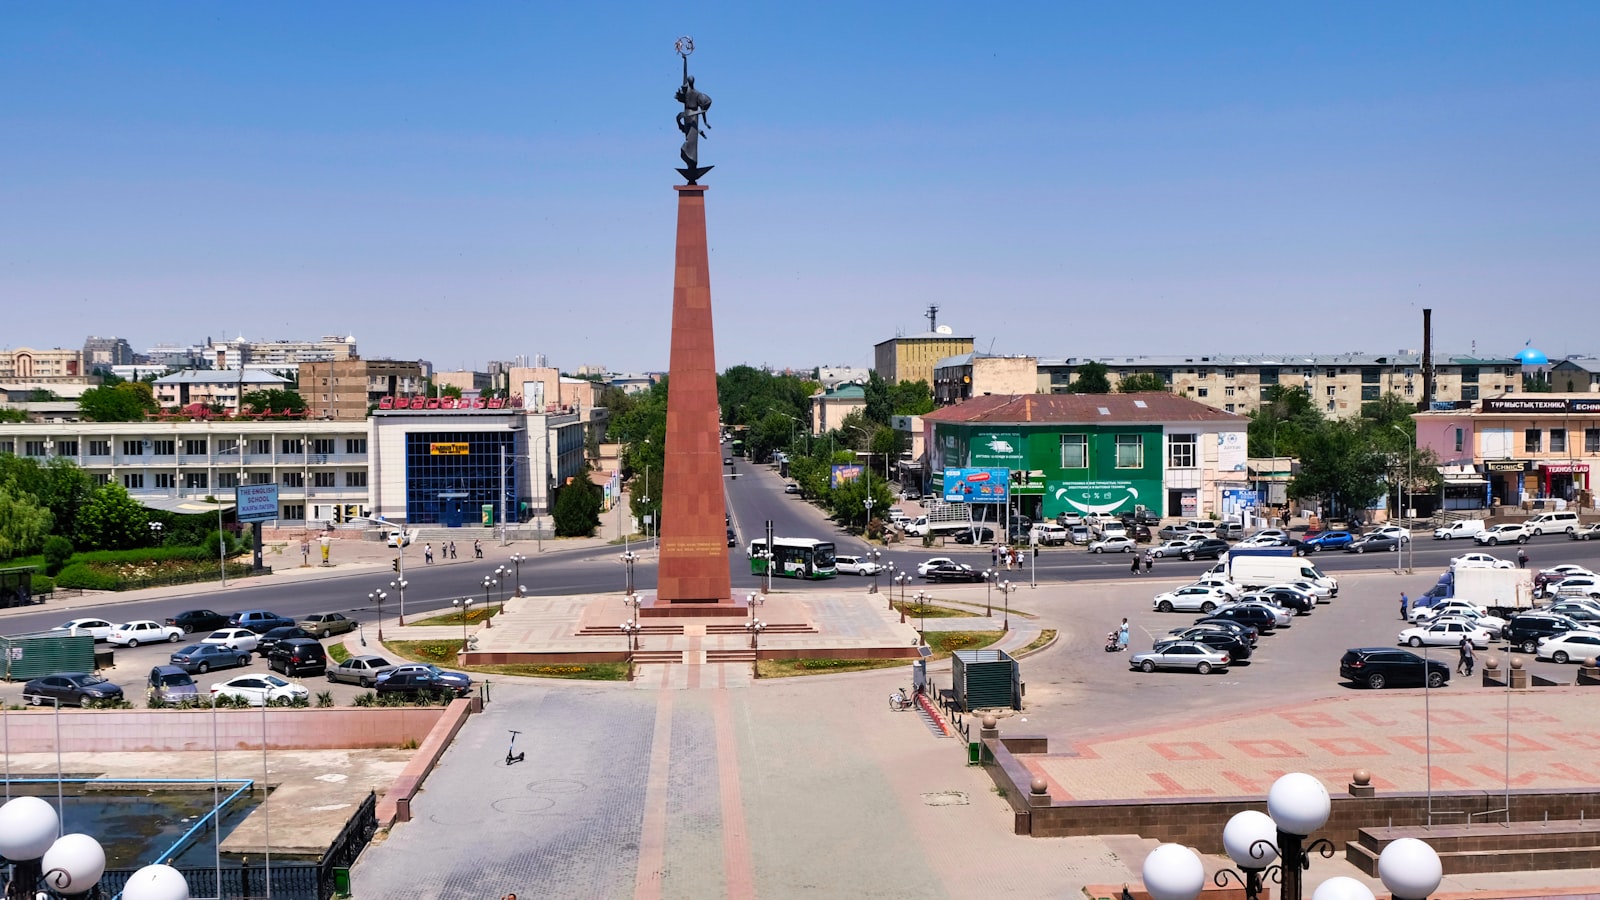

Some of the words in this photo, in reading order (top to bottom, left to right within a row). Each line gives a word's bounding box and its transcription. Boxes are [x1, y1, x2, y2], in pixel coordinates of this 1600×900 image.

[1486, 461, 1525, 472] TECHNICS
[252, 487, 275, 495] ENGLISH
[247, 496, 270, 504] SCHOOL
